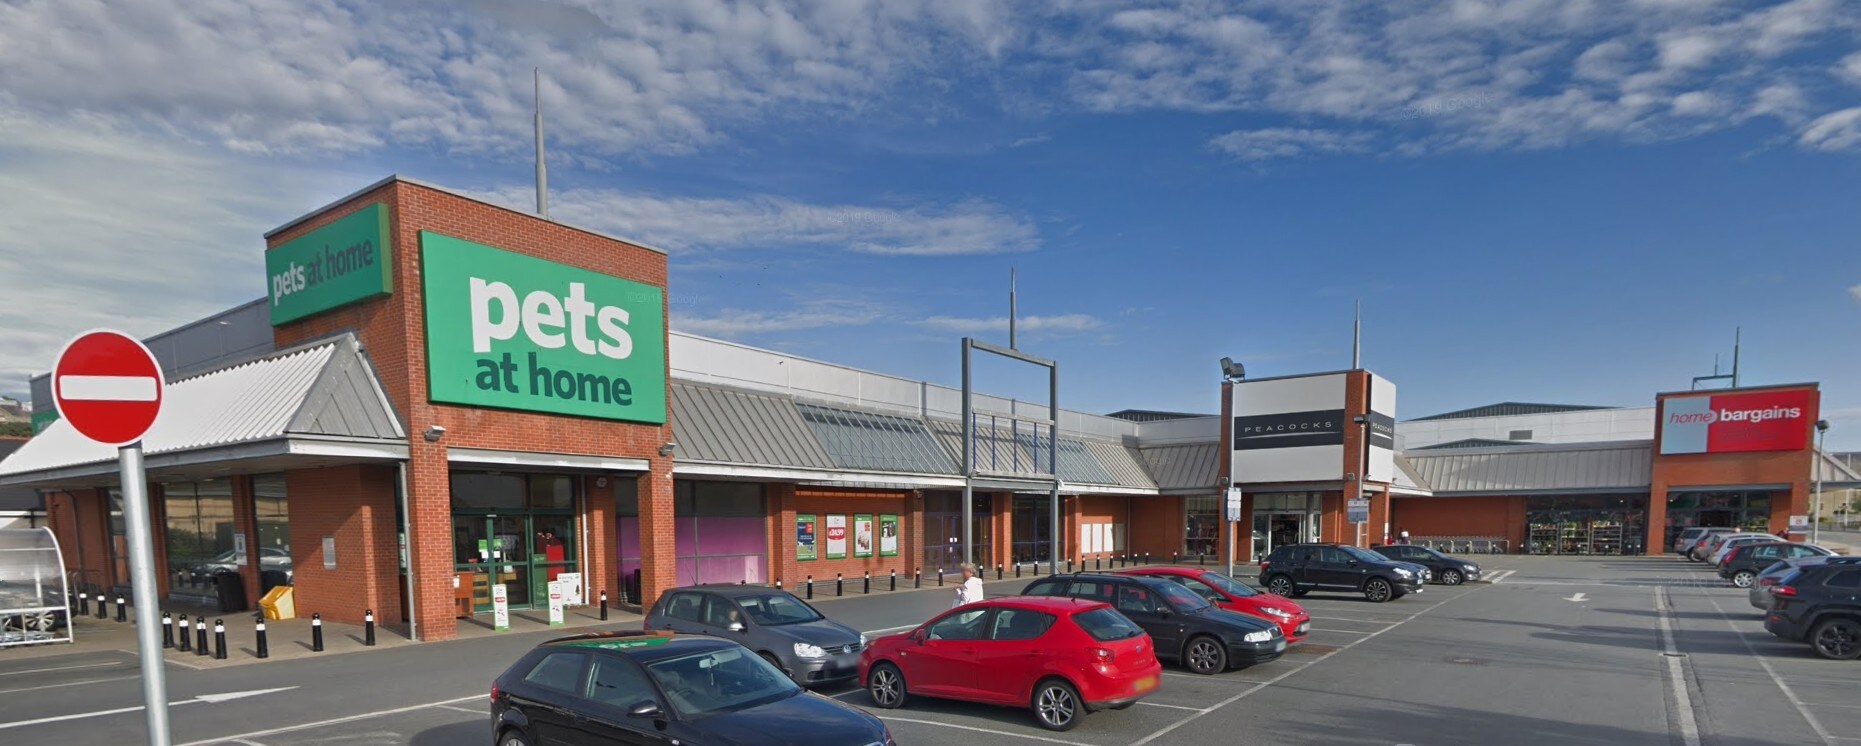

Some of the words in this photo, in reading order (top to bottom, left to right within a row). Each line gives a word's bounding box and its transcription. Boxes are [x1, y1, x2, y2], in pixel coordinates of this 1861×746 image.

[273, 261, 306, 307] pets
[308, 251, 324, 287] at
[325, 239, 374, 280] home
[469, 276, 633, 360] pets
[475, 352, 519, 394] at
[528, 351, 633, 407] home
[1244, 421, 1332, 433] PEACOCKS
[1372, 422, 1393, 434] PEACOCKS
[1669, 411, 1713, 425] home
[1720, 405, 1802, 423] bargains
